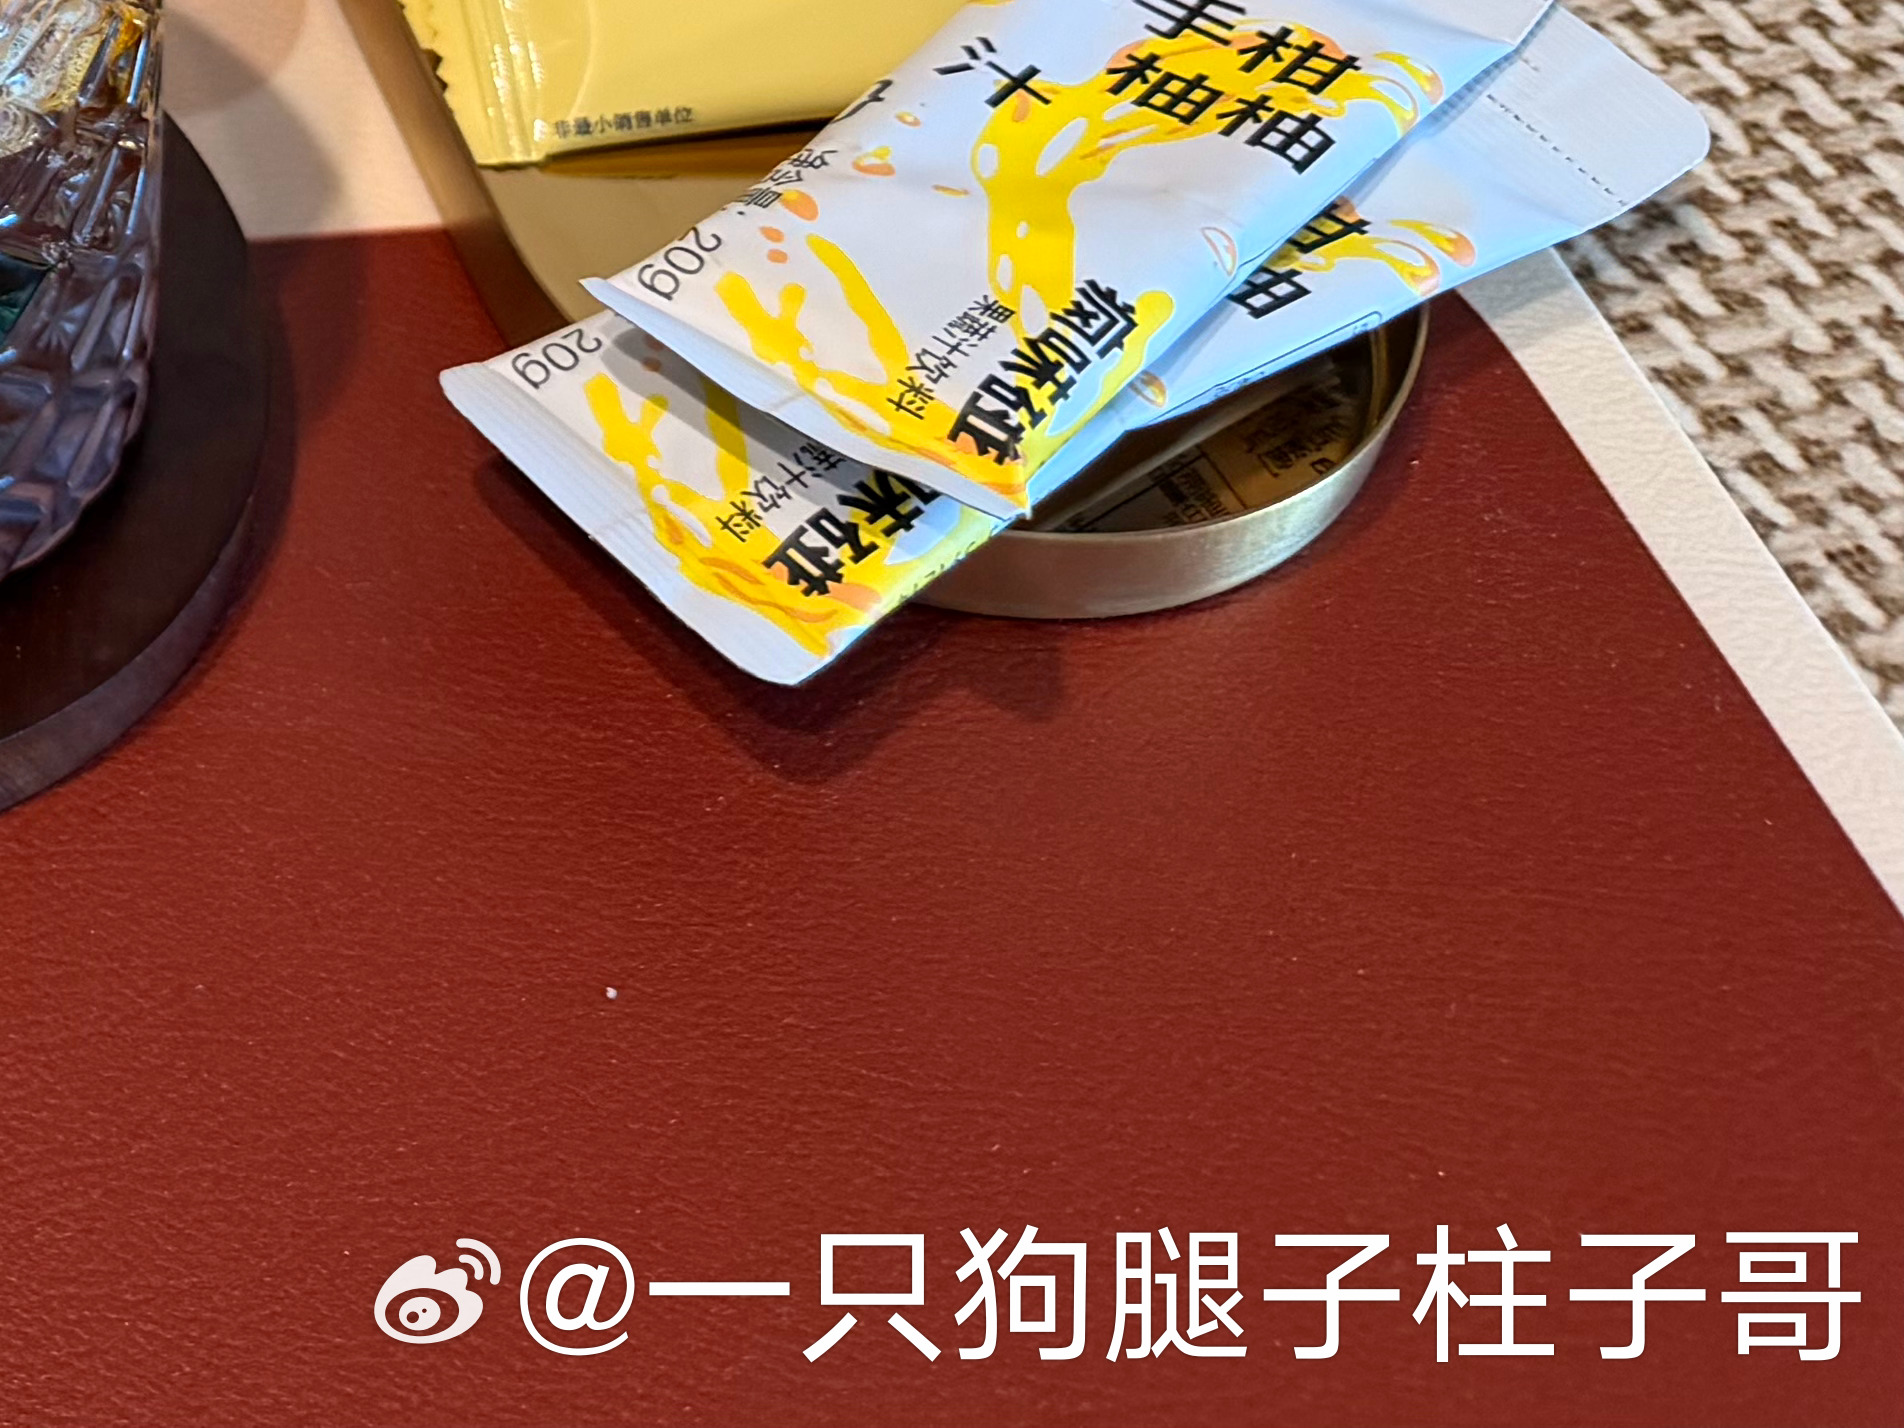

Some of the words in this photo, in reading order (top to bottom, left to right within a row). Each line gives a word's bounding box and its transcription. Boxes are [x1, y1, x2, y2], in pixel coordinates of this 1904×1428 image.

[553, 106, 694, 141] 非最小销售单位
[637, 226, 722, 302] 20g
[511, 328, 603, 389] 20g
[886, 295, 1016, 421] 果蔬汁饮料
[947, 280, 1141, 466] 疯味碰
[763, 470, 942, 597] 味碰
